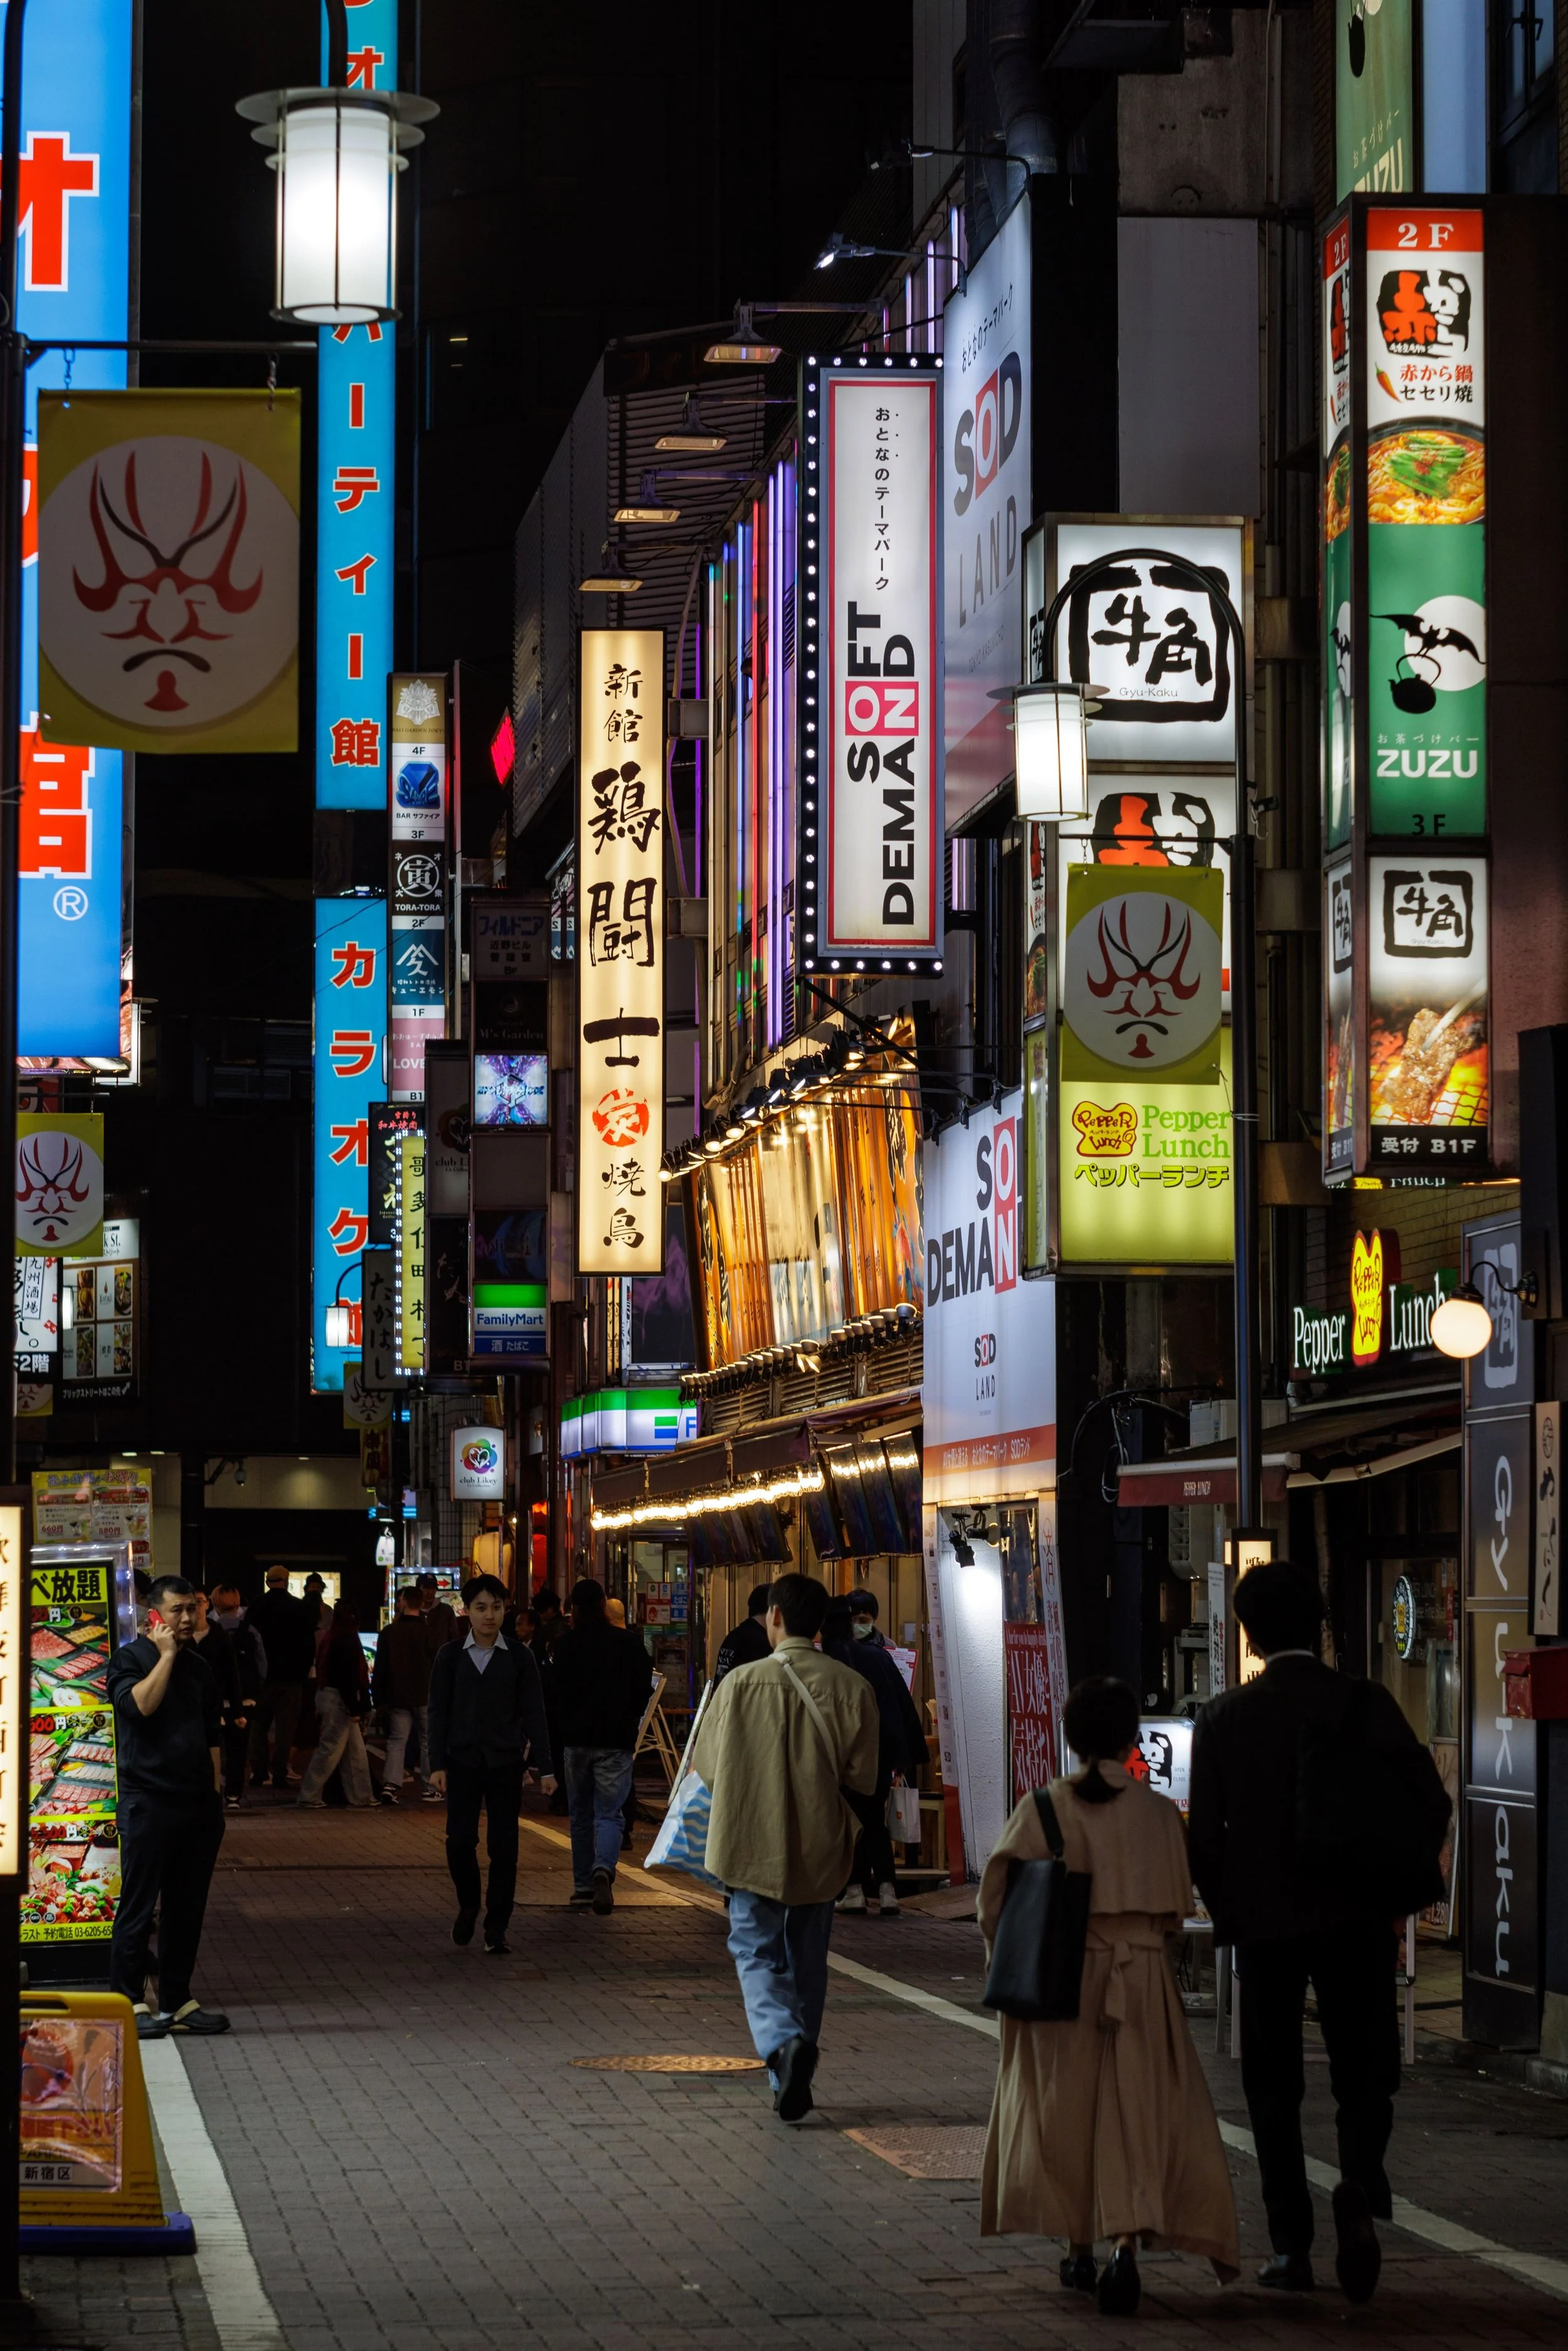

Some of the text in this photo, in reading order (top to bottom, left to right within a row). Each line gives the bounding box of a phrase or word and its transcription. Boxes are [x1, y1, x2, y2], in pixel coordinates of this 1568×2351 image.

[961, 282, 1013, 374] おとなのテーマパーク
[1399, 363, 1474, 383] 赤から鍋
[954, 351, 1022, 517] SOD
[874, 407, 891, 591] おとなのテーマパーク
[959, 495, 1017, 629] LAND
[1091, 593, 1214, 687] 牛角
[603, 666, 645, 745] 新館
[1118, 686, 1179, 699] Gyu-Kaku
[412, 746, 426, 755] 4F
[1377, 749, 1478, 778] ZUZU
[411, 831, 425, 839] 3F
[403, 859, 434, 890] 寅
[411, 919, 425, 928] 2F
[582, 760, 662, 1068] 鶏闘士
[1396, 885, 1464, 939] 牛角
[412, 1009, 425, 1017] 1F
[502, 1029, 543, 1039] Garden
[1142, 1105, 1231, 1132] Pepper
[1088, 1135, 1123, 1150] Lunch
[1142, 1133, 1231, 1159] Lunch
[1343, 1137, 1353, 1157] B1
[1381, 1137, 1477, 1154] 受付 B1F
[1074, 1162, 1230, 1188] ペッパーランチ
[600, 1160, 646, 1248] 焼鳥
[926, 1213, 1022, 1308] DEMAN
[26, 1257, 42, 1314] 九州酒場
[370, 1272, 393, 1380] たかはし
[477, 1312, 544, 1327] FamilyMart
[491, 1339, 530, 1352] 酒 たばこ
[974, 1333, 997, 1368] SOD
[1293, 1306, 1345, 1375] Pepper
[976, 1374, 996, 1401] LAND
[460, 1476, 498, 1486] club Likey
[41, 1524, 63, 1533] 660円
[98, 1527, 121, 1535] 880円
[31, 1569, 102, 1605] べ放題
[43, 1926, 73, 1940] 予約電話
[24, 2165, 72, 2181] 新宿区
